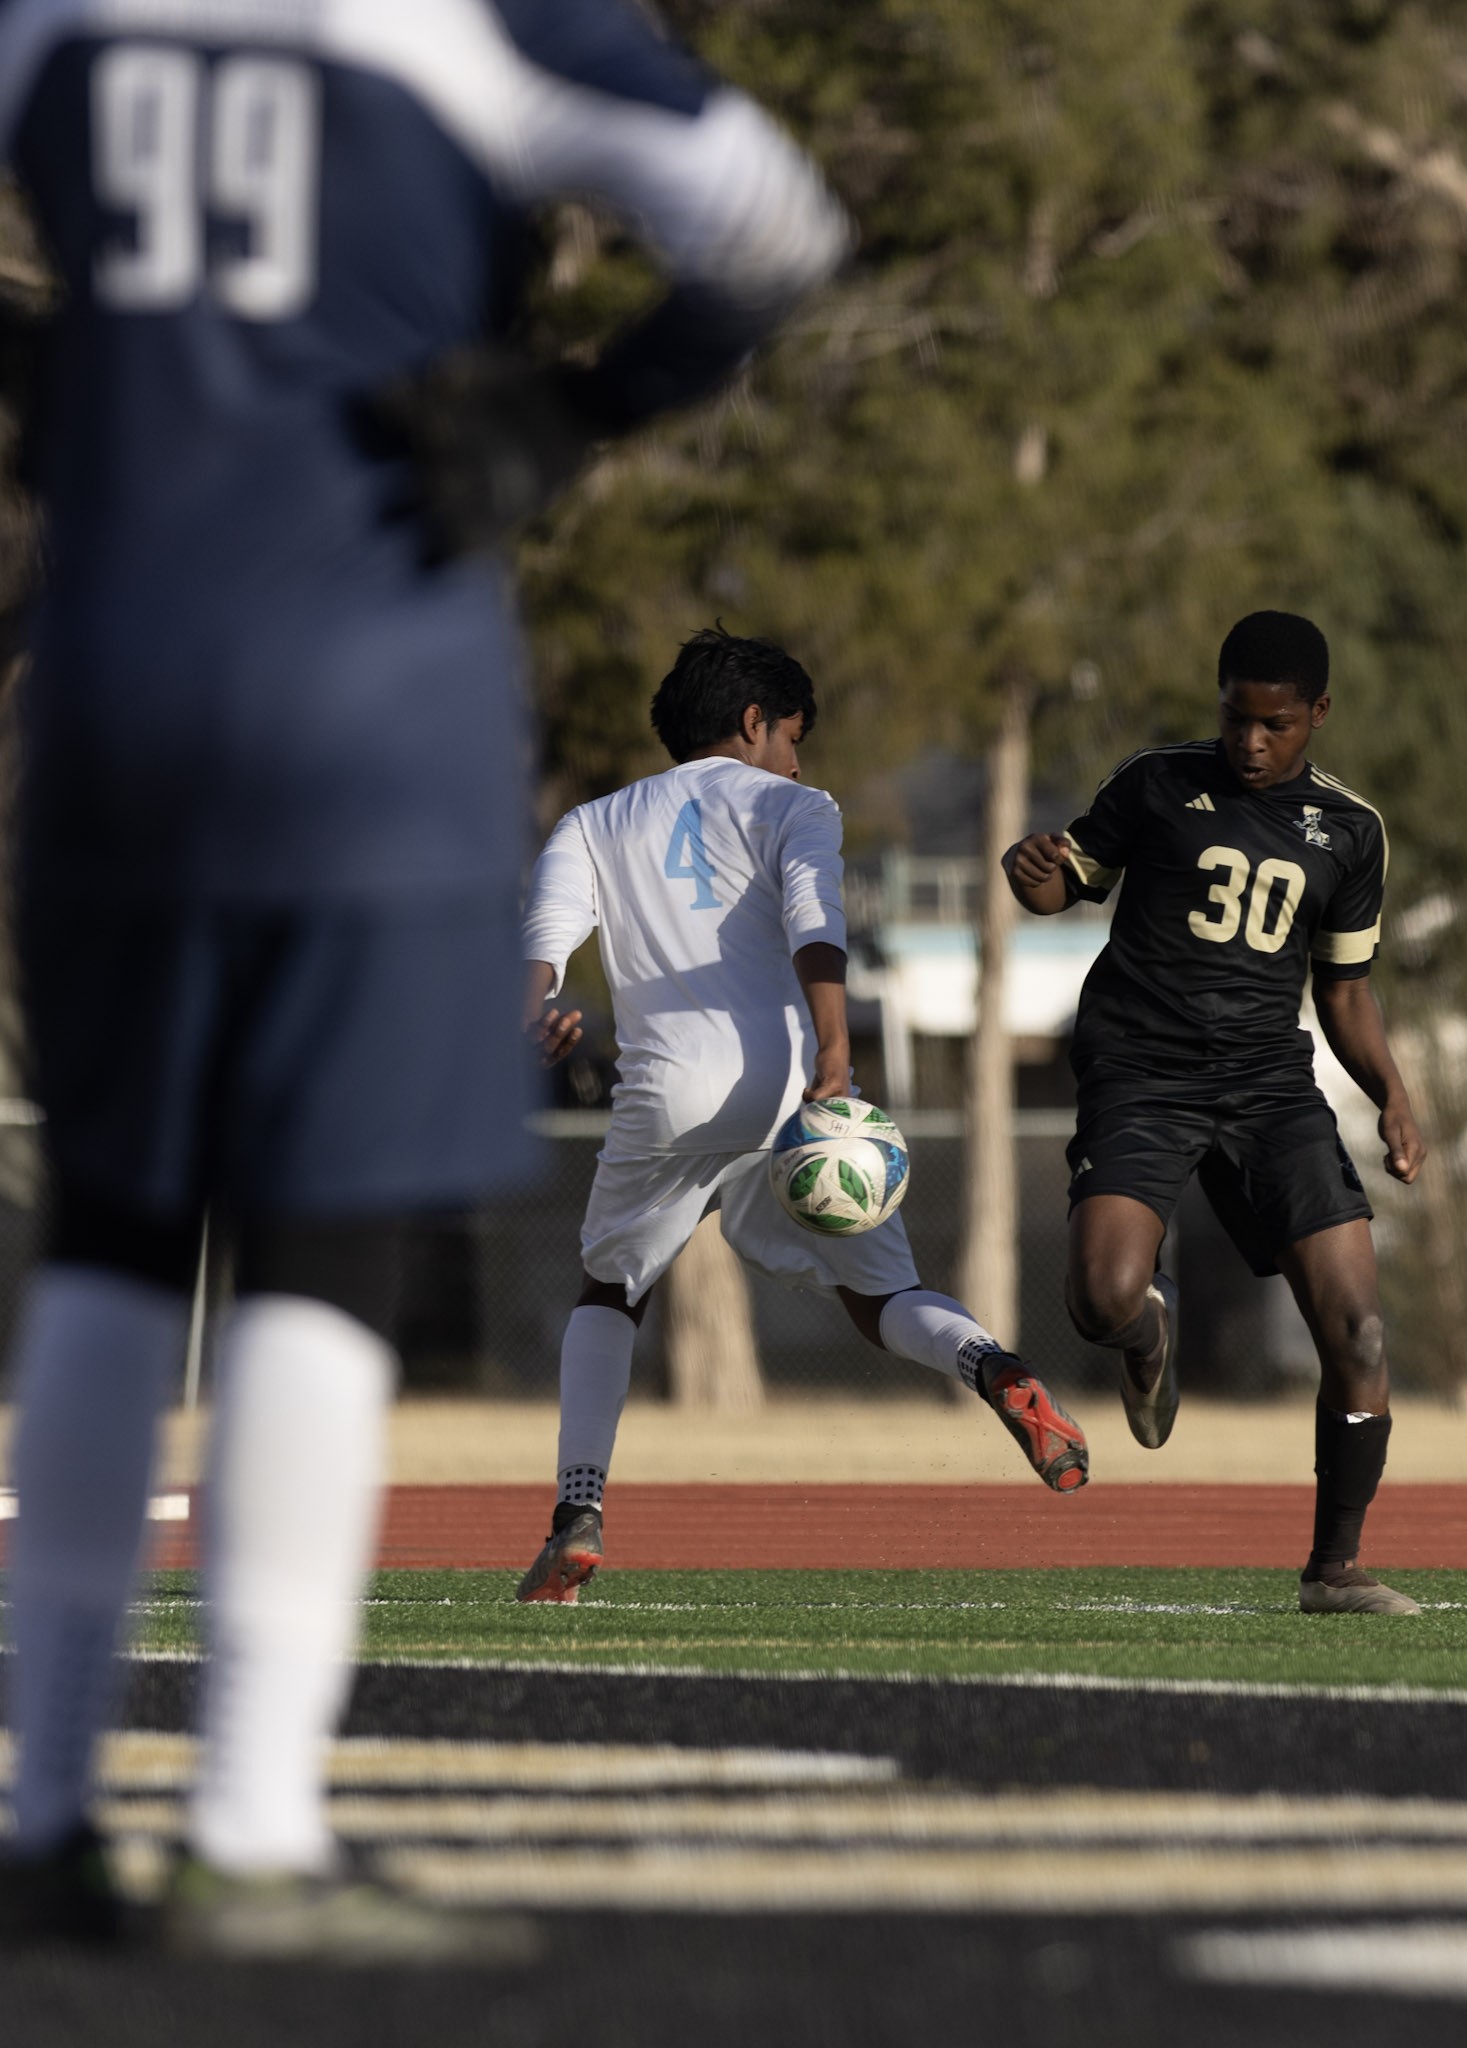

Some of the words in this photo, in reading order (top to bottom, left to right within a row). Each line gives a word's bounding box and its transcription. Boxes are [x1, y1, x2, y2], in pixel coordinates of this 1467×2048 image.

[92, 45, 320, 318] 99
[664, 798, 724, 911] 4
[1187, 845, 1307, 954] 30
